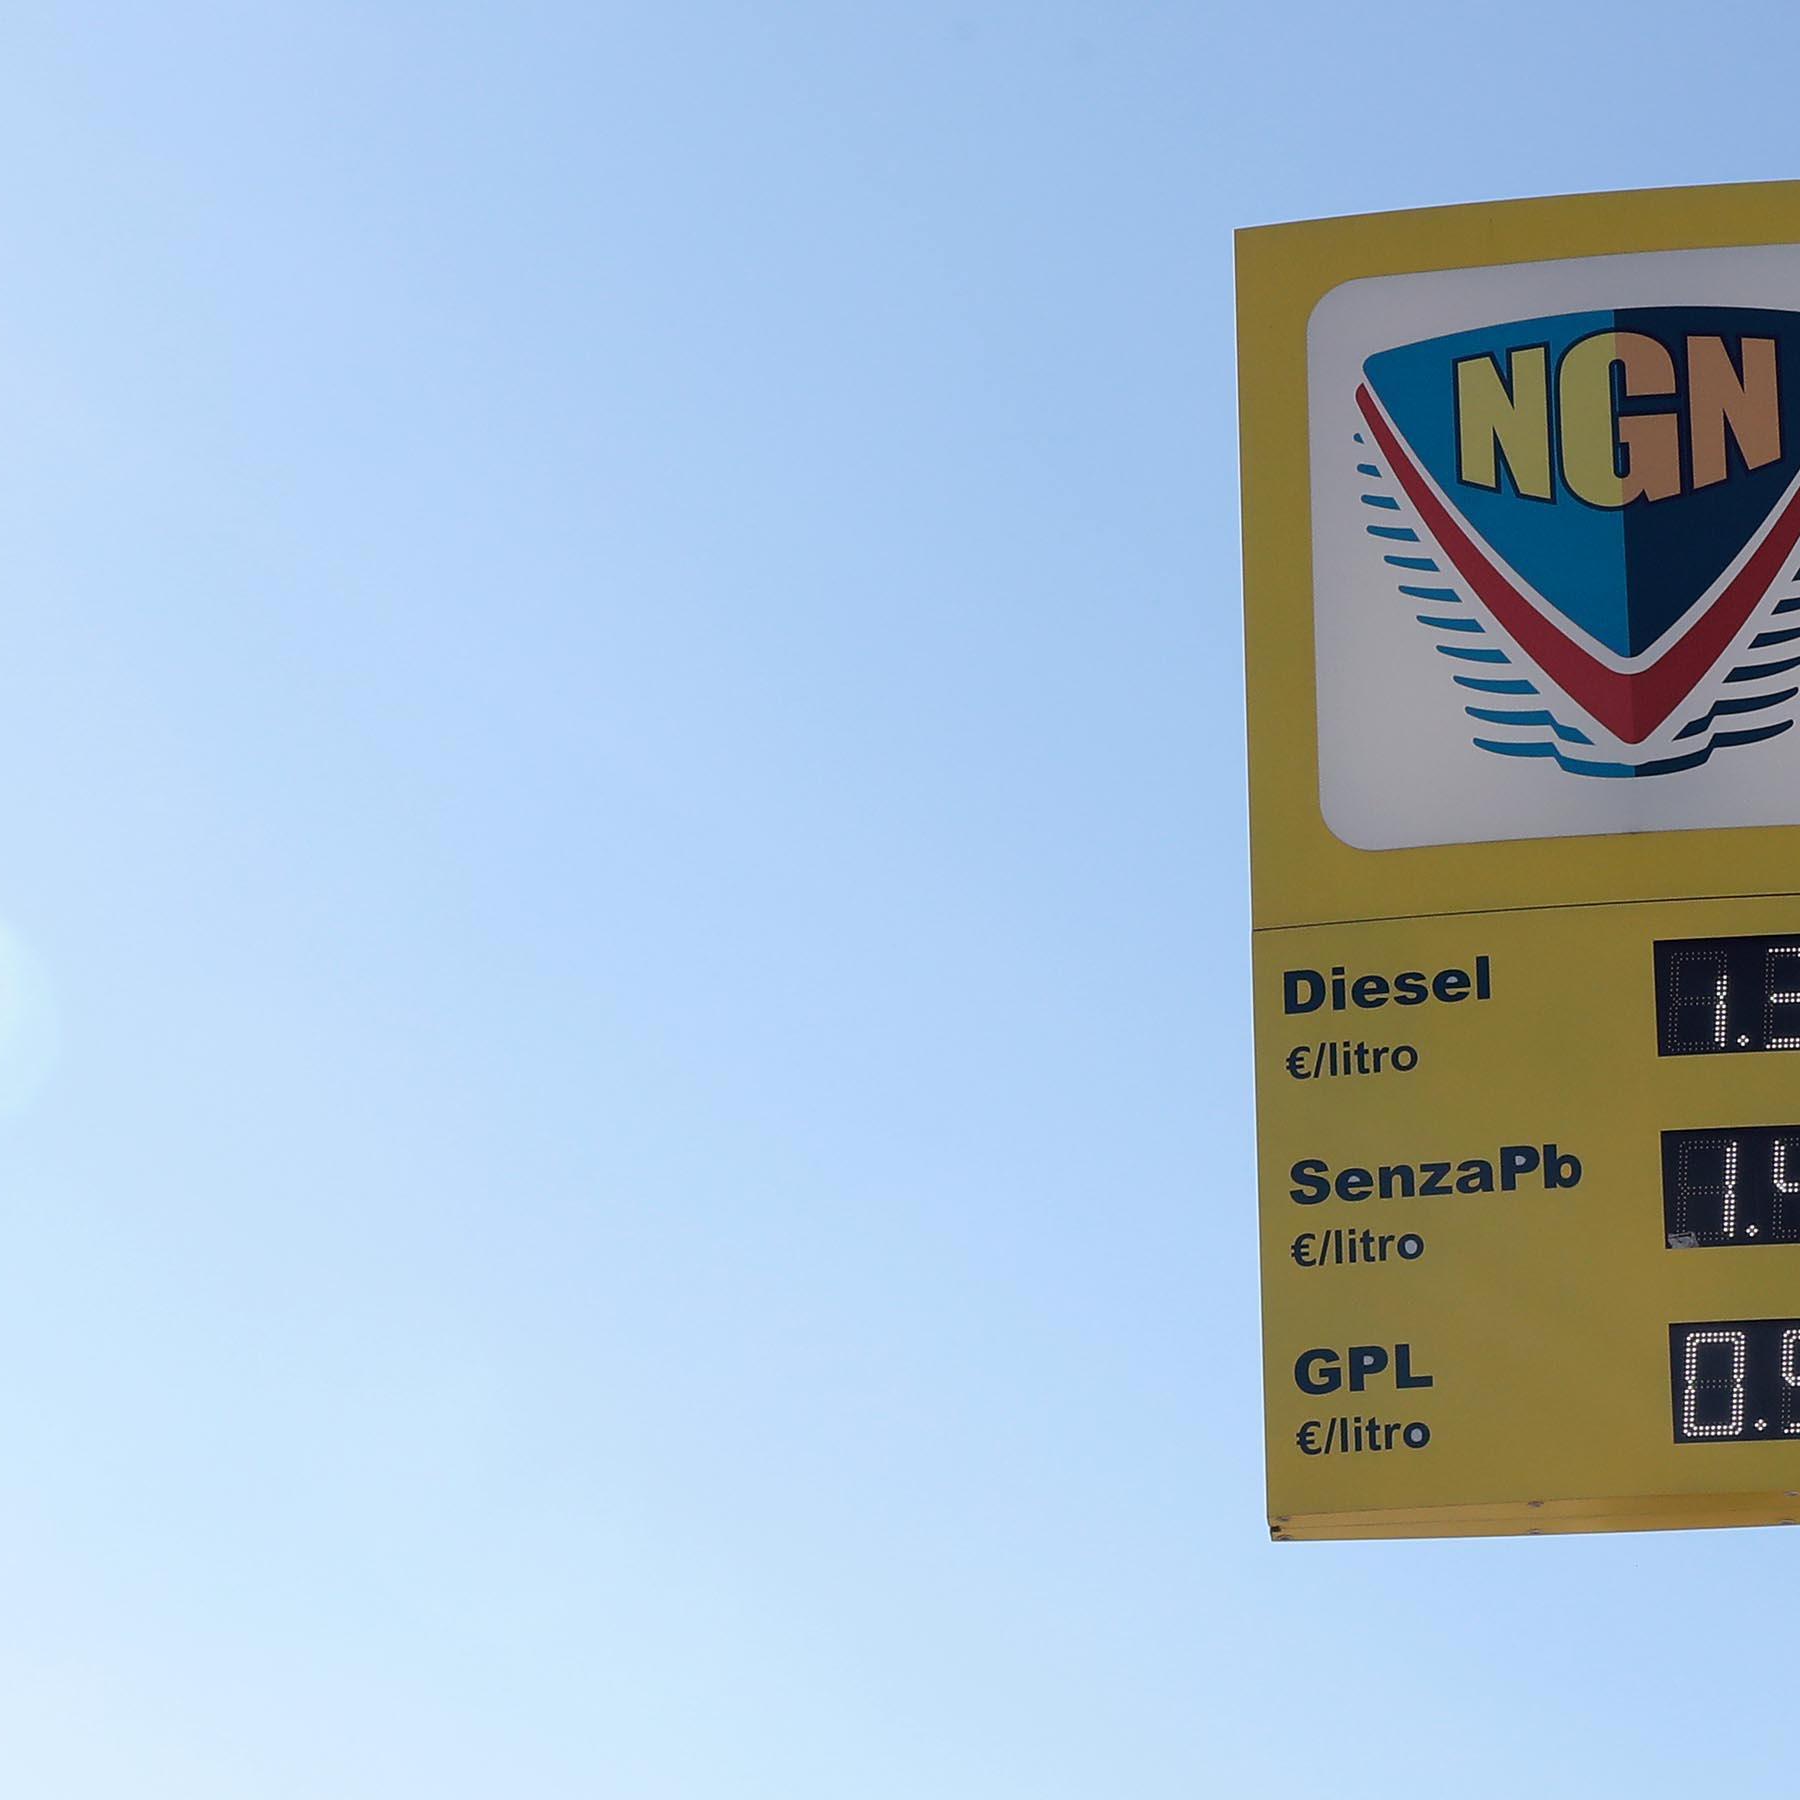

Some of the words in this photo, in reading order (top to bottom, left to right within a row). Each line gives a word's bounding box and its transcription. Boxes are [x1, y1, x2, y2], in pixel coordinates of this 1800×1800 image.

[1452, 330, 1785, 509] NGN
[1283, 956, 1492, 1015] Diesel
[1286, 1041, 1419, 1081] €/litro
[1289, 1144, 1584, 1206] SenzaPb
[1290, 1230, 1426, 1269] €/litro
[1293, 1344, 1434, 1396] GPL
[1296, 1419, 1432, 1457] €/litro
